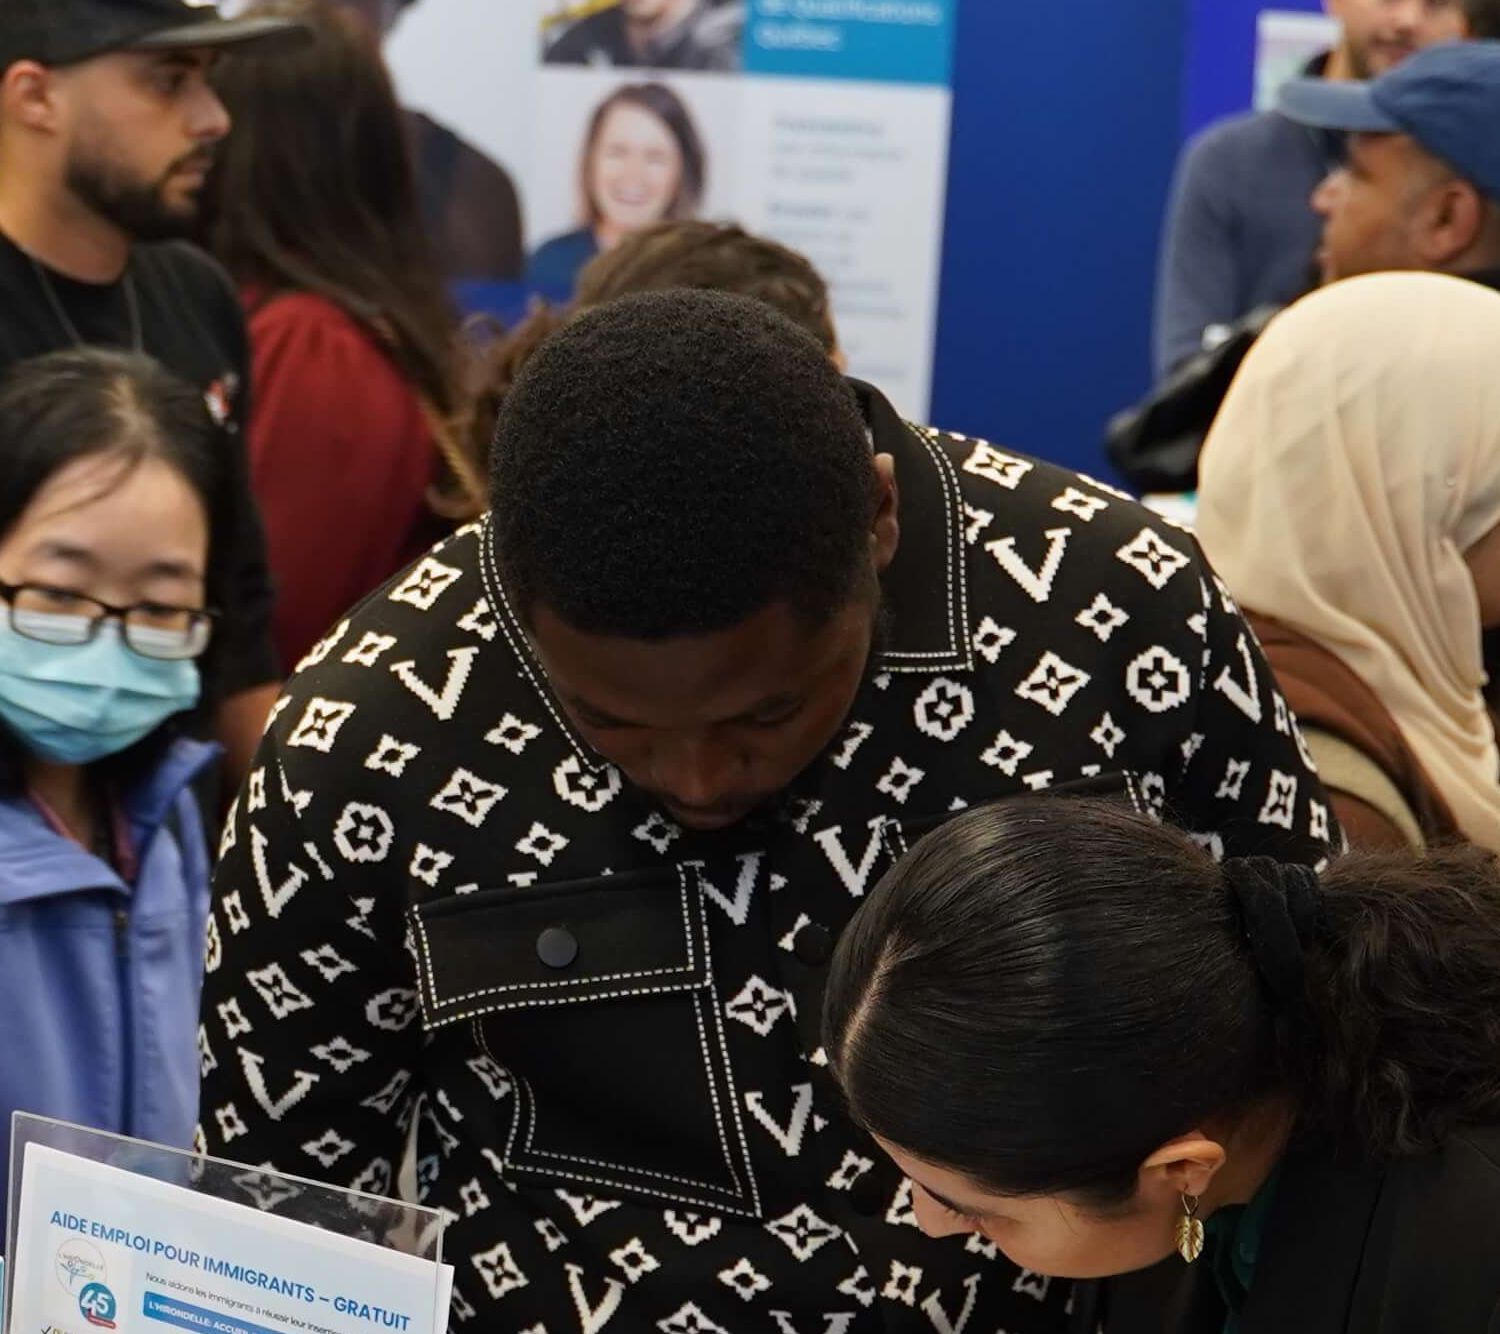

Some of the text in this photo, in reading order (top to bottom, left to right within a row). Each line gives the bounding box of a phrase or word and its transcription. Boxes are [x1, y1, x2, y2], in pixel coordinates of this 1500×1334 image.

[50, 1211, 411, 1332] AIDE EMPLOI POUR IMMIGRANTS GRATUIT
[81, 1289, 109, 1316] 45
[146, 1272, 167, 1286] Nous
[196, 1285, 207, 1298] les
[208, 1289, 255, 1314] immigrants
[263, 1304, 290, 1323] réussir
[291, 1314, 306, 1328] leur
